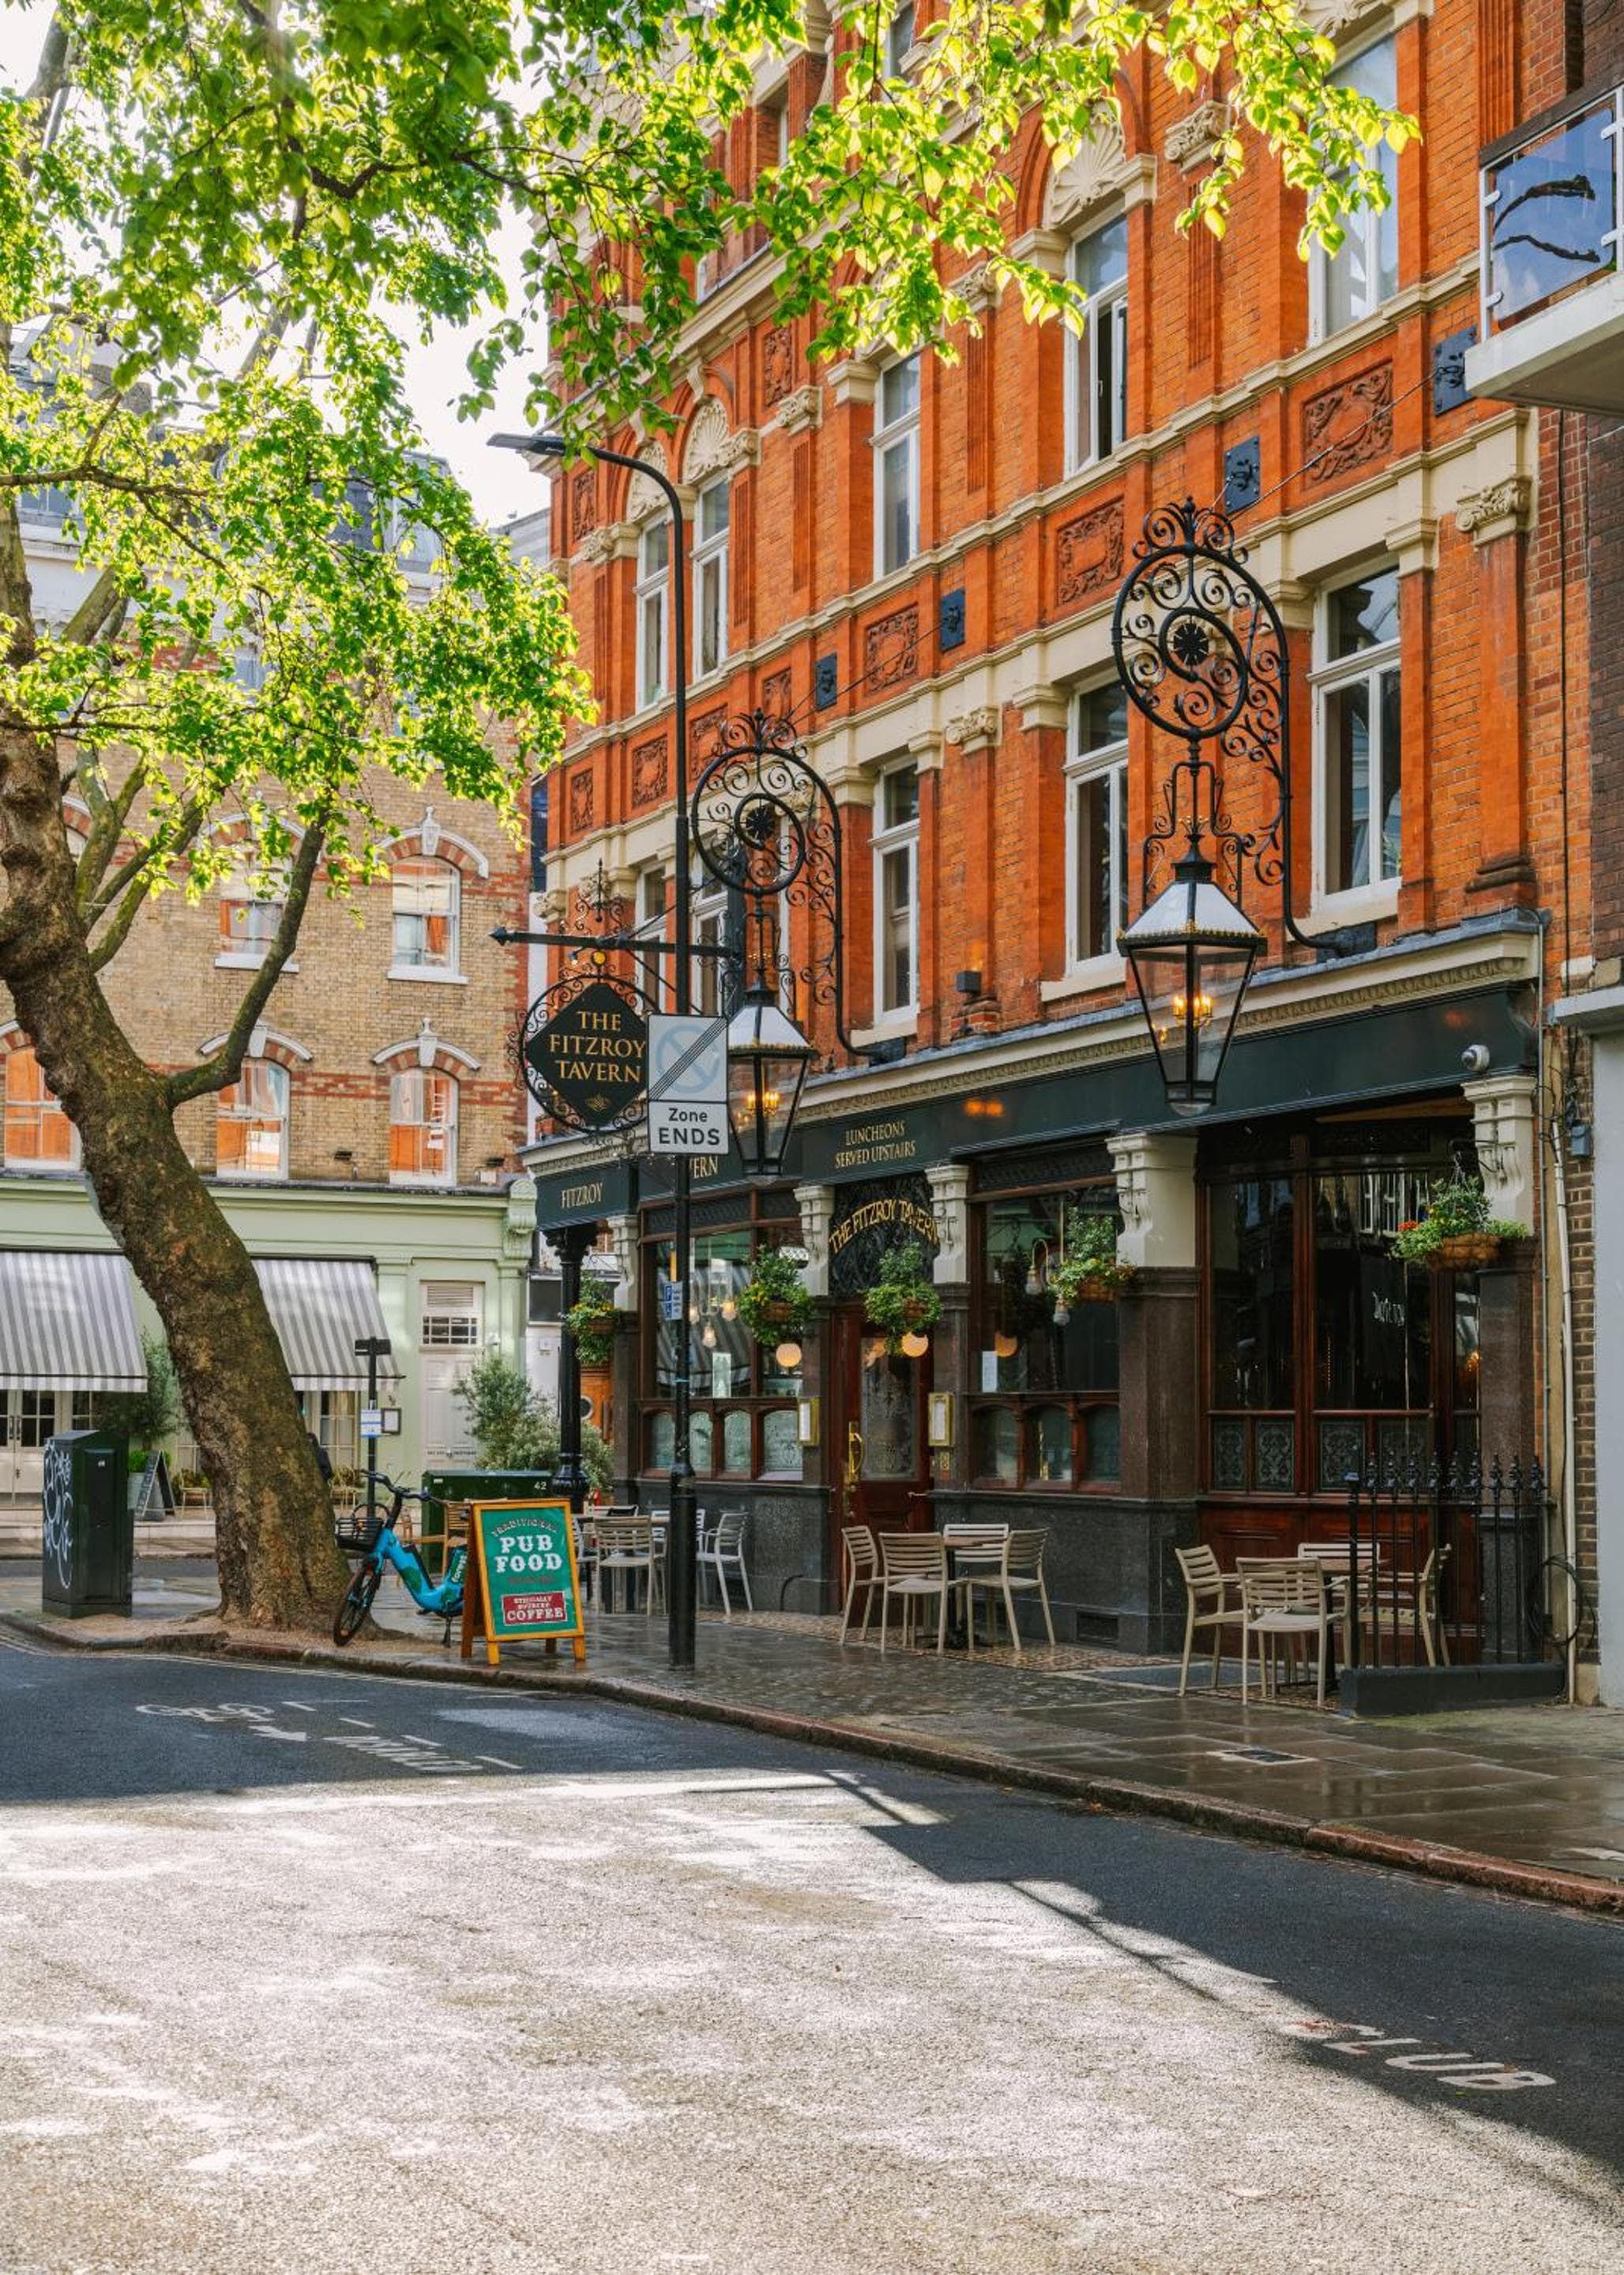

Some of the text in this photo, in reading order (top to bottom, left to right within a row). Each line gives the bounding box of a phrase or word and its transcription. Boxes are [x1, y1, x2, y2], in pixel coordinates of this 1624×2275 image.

[577, 1011, 621, 1032] THE
[549, 1034, 646, 1059] FITZROY
[555, 1061, 641, 1083] TAVERN
[668, 1107, 708, 1122] Zone
[658, 1128, 720, 1145] ENDS
[844, 1120, 905, 1145] LUNCHEONS
[834, 1140, 916, 1168] SERVED UPSTAIRS
[562, 1183, 603, 1209] FITZROY
[828, 1199, 938, 1253] THE FITZROY TAVERN
[534, 1480, 547, 1490] 42
[499, 1534, 553, 1554] PUB
[494, 1553, 563, 1574] FOOD
[506, 1607, 564, 1621] COFFEE
